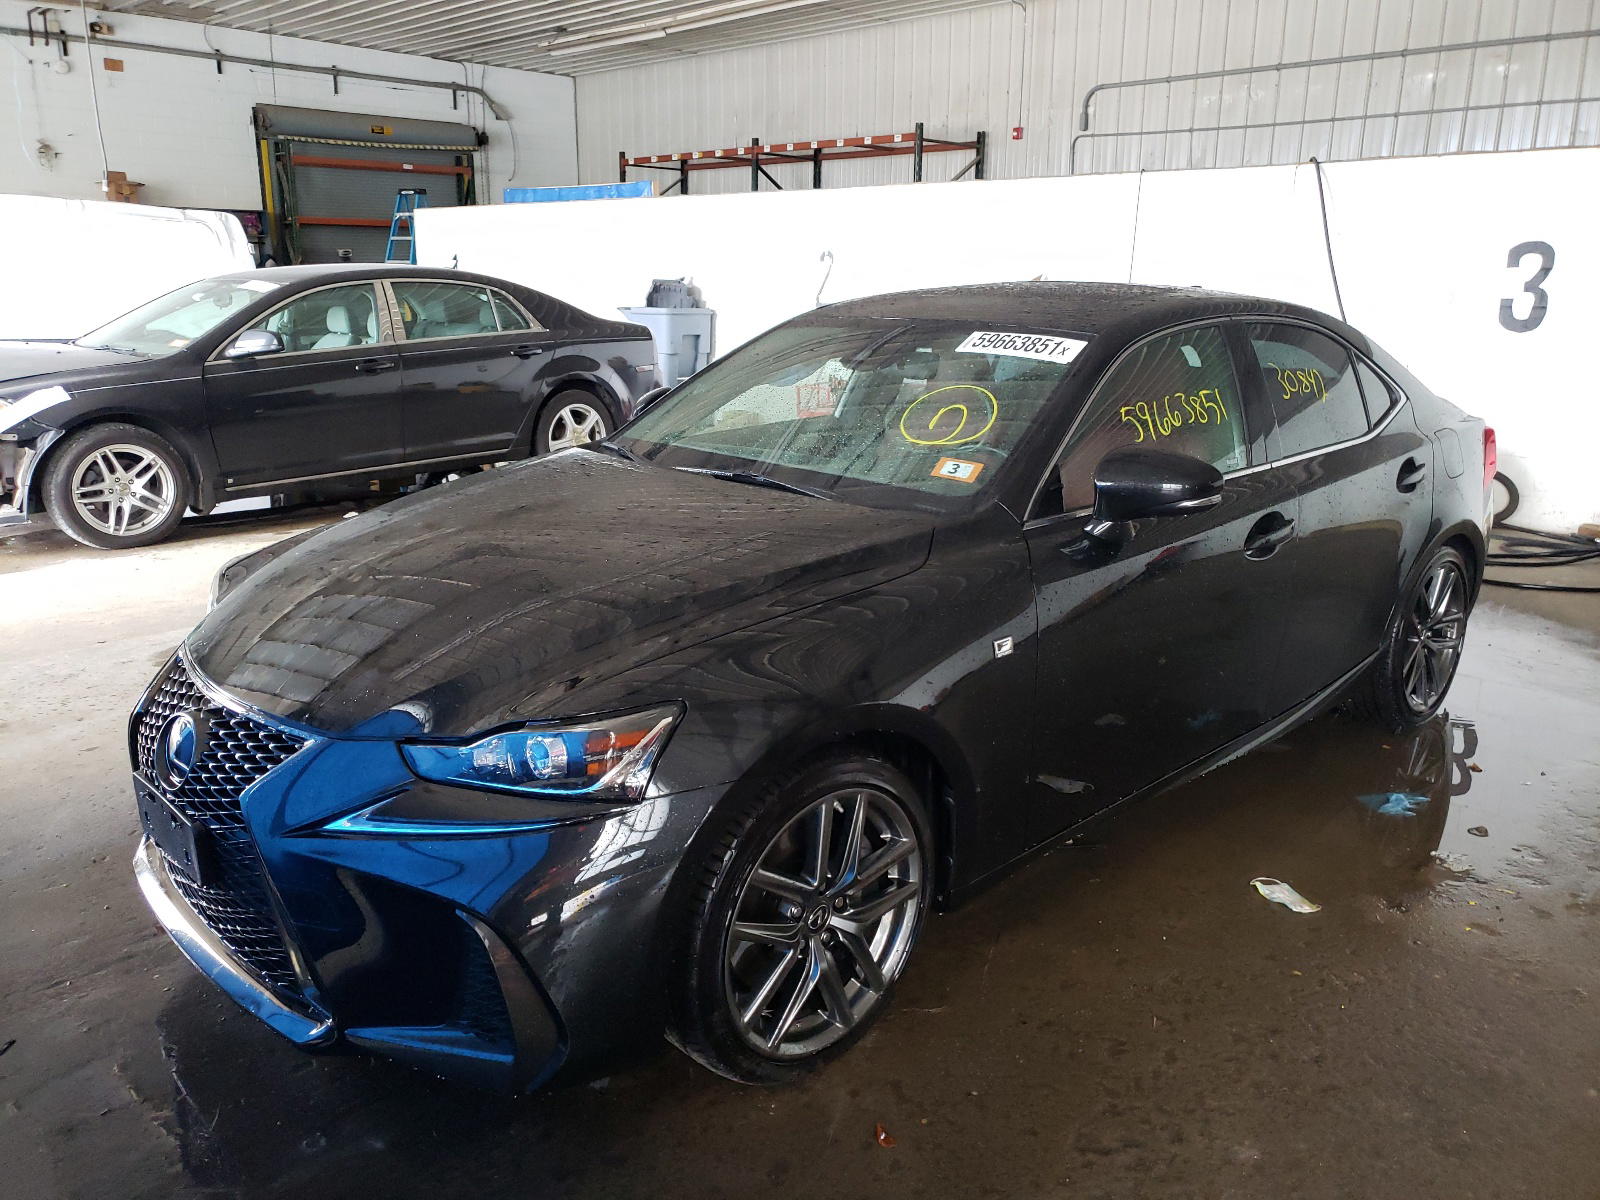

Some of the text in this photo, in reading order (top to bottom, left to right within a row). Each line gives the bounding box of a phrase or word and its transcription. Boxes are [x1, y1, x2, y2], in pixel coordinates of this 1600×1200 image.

[1498, 240, 1556, 333] 3
[1120, 387, 1228, 442] 59663851
[947, 463, 961, 474] 3
